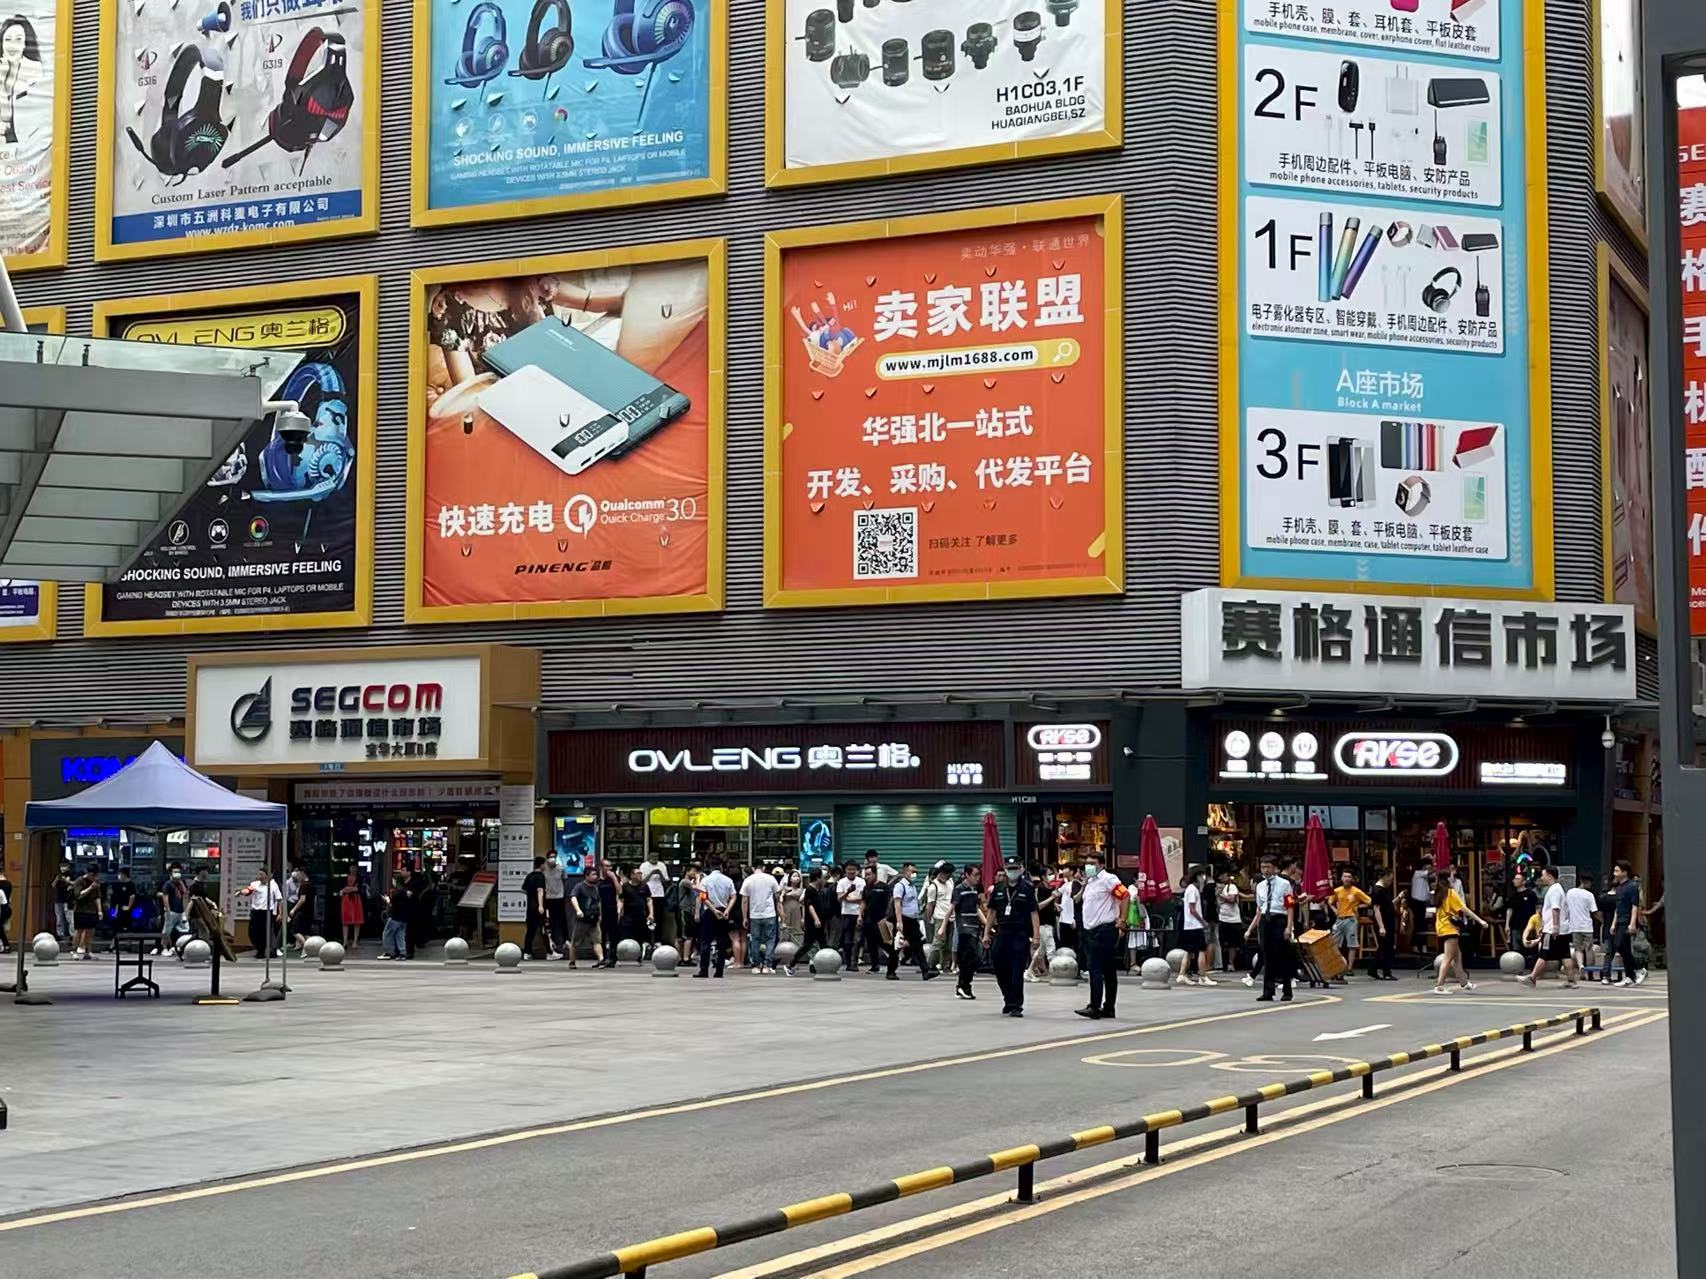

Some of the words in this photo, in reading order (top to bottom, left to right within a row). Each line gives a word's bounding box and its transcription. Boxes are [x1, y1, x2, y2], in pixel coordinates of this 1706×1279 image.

[1253, 17, 1277, 28] mobile
[1279, 21, 1301, 32] phone
[1269, 1, 1477, 41] 手机壳、膜、套、耳机套、平板皮套
[263, 59, 283, 70] G319
[138, 76, 157, 88] G316
[996, 75, 1084, 103] H1C03,1F
[1254, 68, 1319, 121] 2F
[1005, 99, 1052, 116] BAOHUA
[1054, 95, 1085, 109] BLDG
[991, 108, 1086, 130] HUAQIANGBEI,SZ
[453, 150, 513, 167] SHOCKING
[516, 146, 561, 160] SOUND,
[563, 137, 629, 155] IMMERSIVE
[632, 130, 684, 147] FEELING
[647, 151, 658, 160] OR
[1279, 152, 1471, 186] 手机周边配件、平板电脑、安防产品
[151, 191, 193, 206] Custom
[197, 187, 227, 200] Laser
[230, 183, 271, 197] Pattern
[273, 175, 333, 194] acceptable
[1269, 171, 1299, 182] mobile
[1300, 174, 1326, 186] phone
[1327, 176, 1377, 190] accessories,
[1378, 179, 1408, 193] tablets,
[1409, 183, 1442, 198] security
[1442, 186, 1479, 200] products
[1254, 218, 1314, 271] 1F
[842, 299, 857, 312] Hi!
[873, 272, 1085, 342] 卖家联盟
[260, 317, 331, 340] 奥兰格
[1252, 323, 1284, 332] electronic
[1284, 325, 1313, 334] atomizer
[1330, 328, 1348, 337] smart
[1388, 333, 1408, 344] phone
[1446, 337, 1470, 348] security
[1471, 339, 1498, 349] products
[885, 348, 1034, 373] www.mjlm1688.com
[1336, 368, 1425, 399] A座市场
[1337, 397, 1369, 409] Block
[1372, 399, 1380, 410] A
[1381, 401, 1422, 413] market
[861, 405, 1034, 446] 华强北一站式
[1256, 427, 1321, 481] 3F
[806, 452, 1093, 500] 开发、采购、代发平台
[600, 498, 665, 512] Qualcomm
[437, 499, 555, 538] 快速充电
[600, 513, 628, 525] Quick
[630, 512, 665, 523] Charge
[1282, 516, 1473, 542] 手机壳、膜、套、平板电脑、平板皮套
[929, 535, 971, 550] 扫码关注
[975, 532, 1018, 547] 了解更多
[1266, 535, 1288, 545] mobile
[1289, 536, 1310, 547] phone
[1474, 546, 1489, 554] case
[183, 566, 226, 582] SOUND,
[228, 563, 290, 578] IMMERSIVE
[292, 560, 342, 574] FEELING
[514, 561, 589, 575] PINENG
[143, 590, 176, 599] HEADSET
[176, 590, 195, 598] WITH
[234, 587, 247, 596] MIC
[247, 587, 262, 595] FOR
[273, 585, 305, 594] LAPTOPS
[305, 584, 317, 592] OR
[317, 582, 344, 591] MOBILE
[171, 599, 201, 608] DEVICES
[202, 598, 220, 607] WITH
[268, 596, 287, 604] JACK
[1221, 600, 1628, 671] 赛格通信市场
[291, 683, 442, 712] SEGCOM
[628, 746, 801, 772] OVLENG
